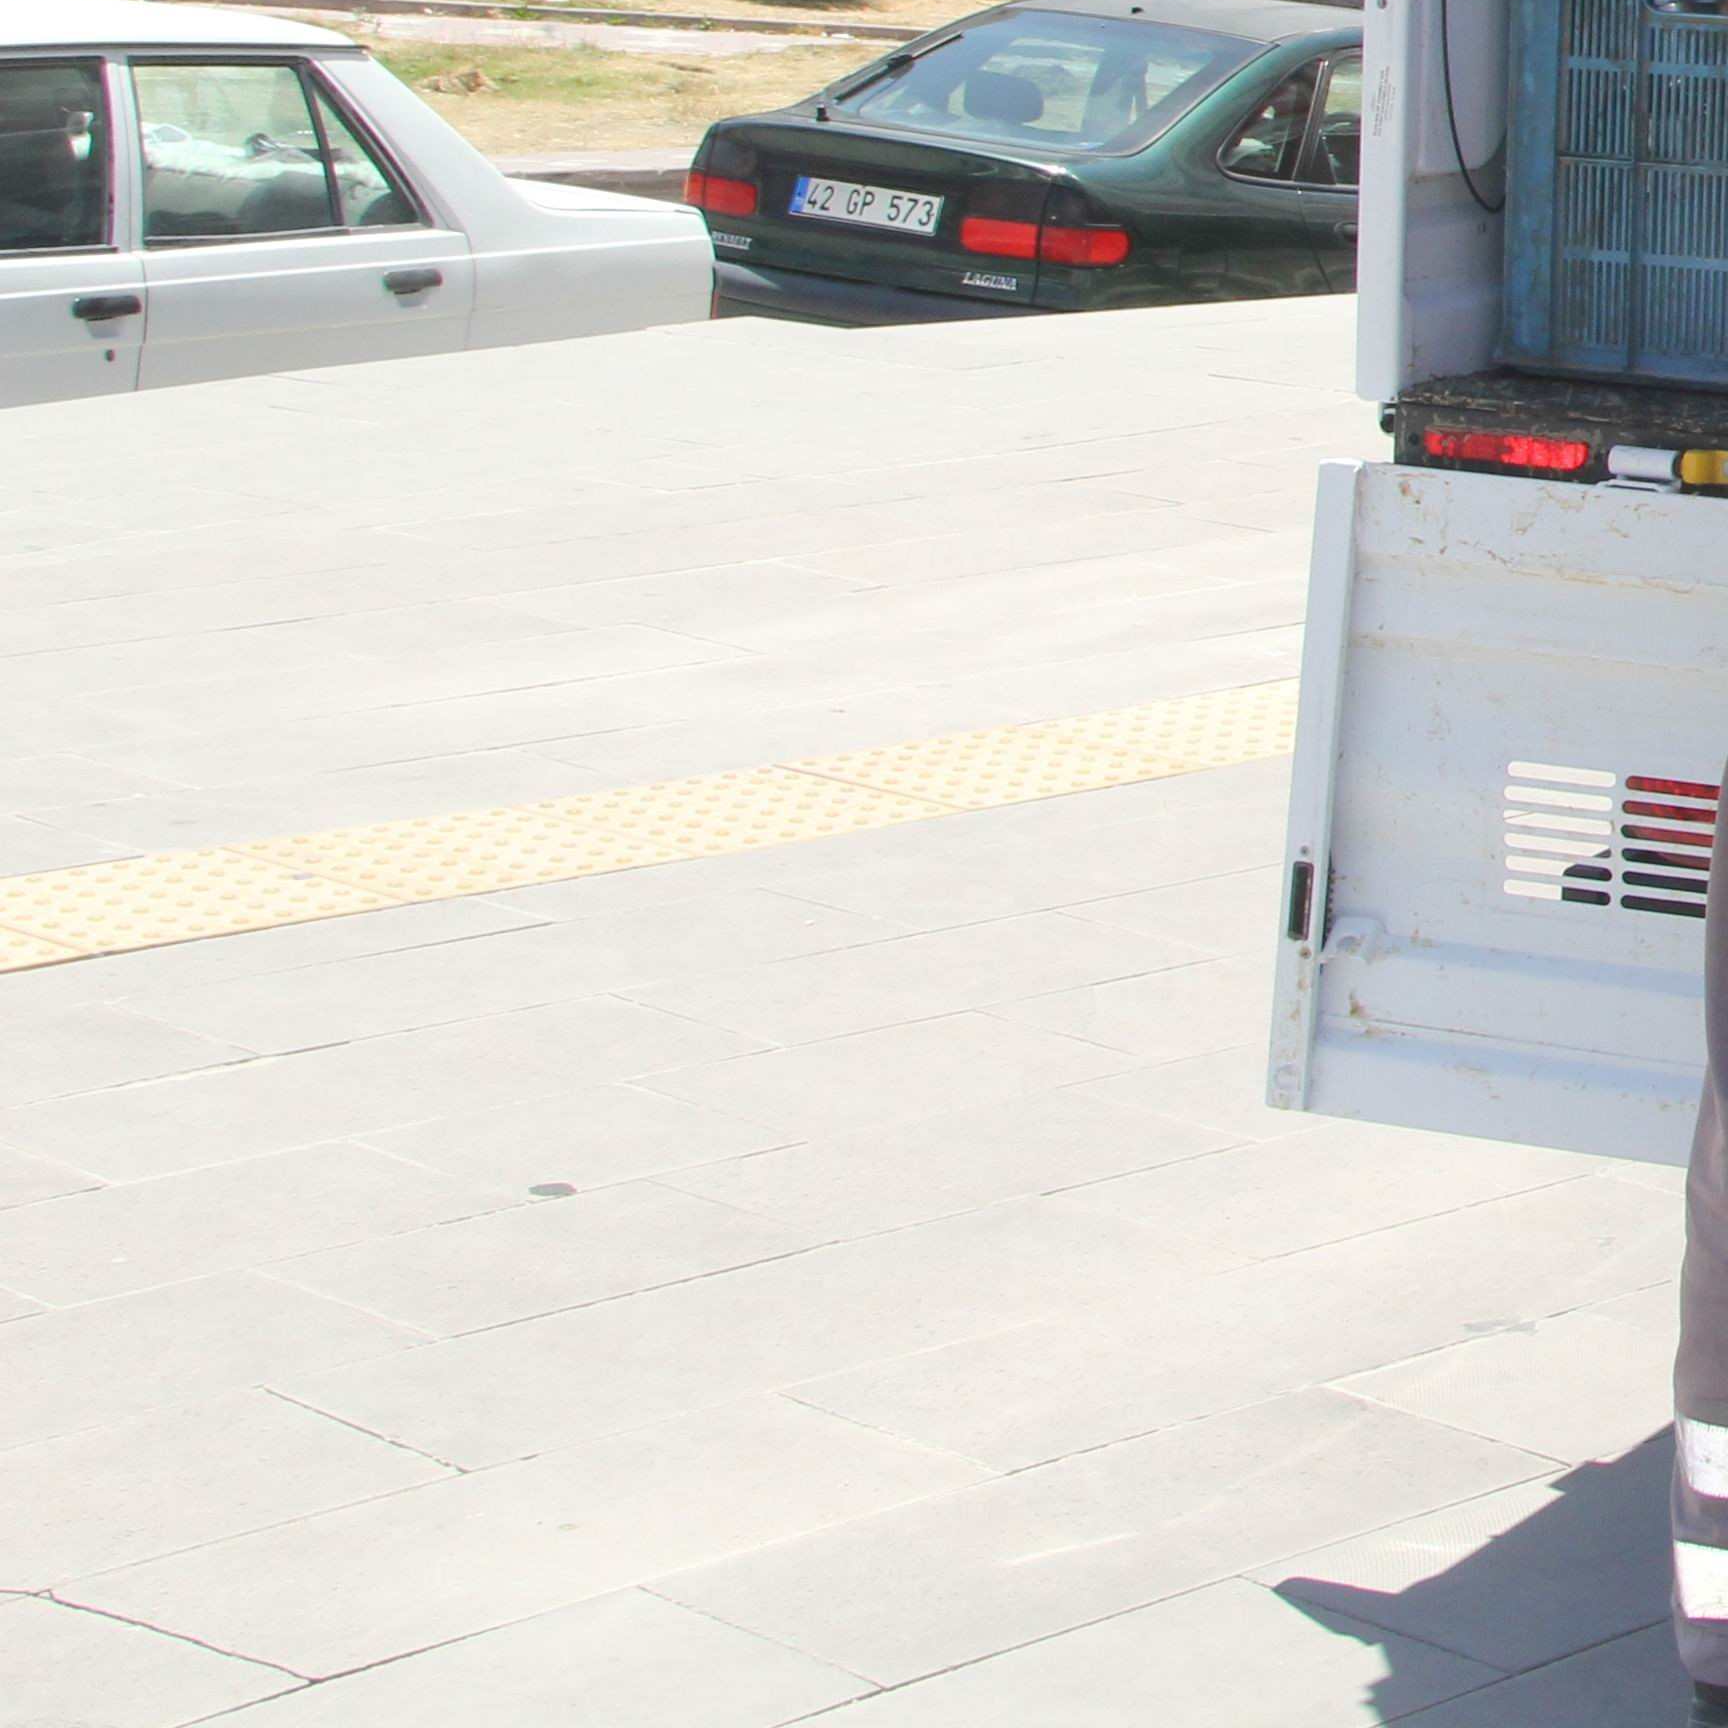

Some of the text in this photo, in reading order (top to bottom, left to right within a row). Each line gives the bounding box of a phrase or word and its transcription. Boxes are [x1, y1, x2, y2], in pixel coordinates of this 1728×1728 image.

[807, 183, 935, 227] 42 GP 573
[962, 271, 1018, 291] LAGUNA
